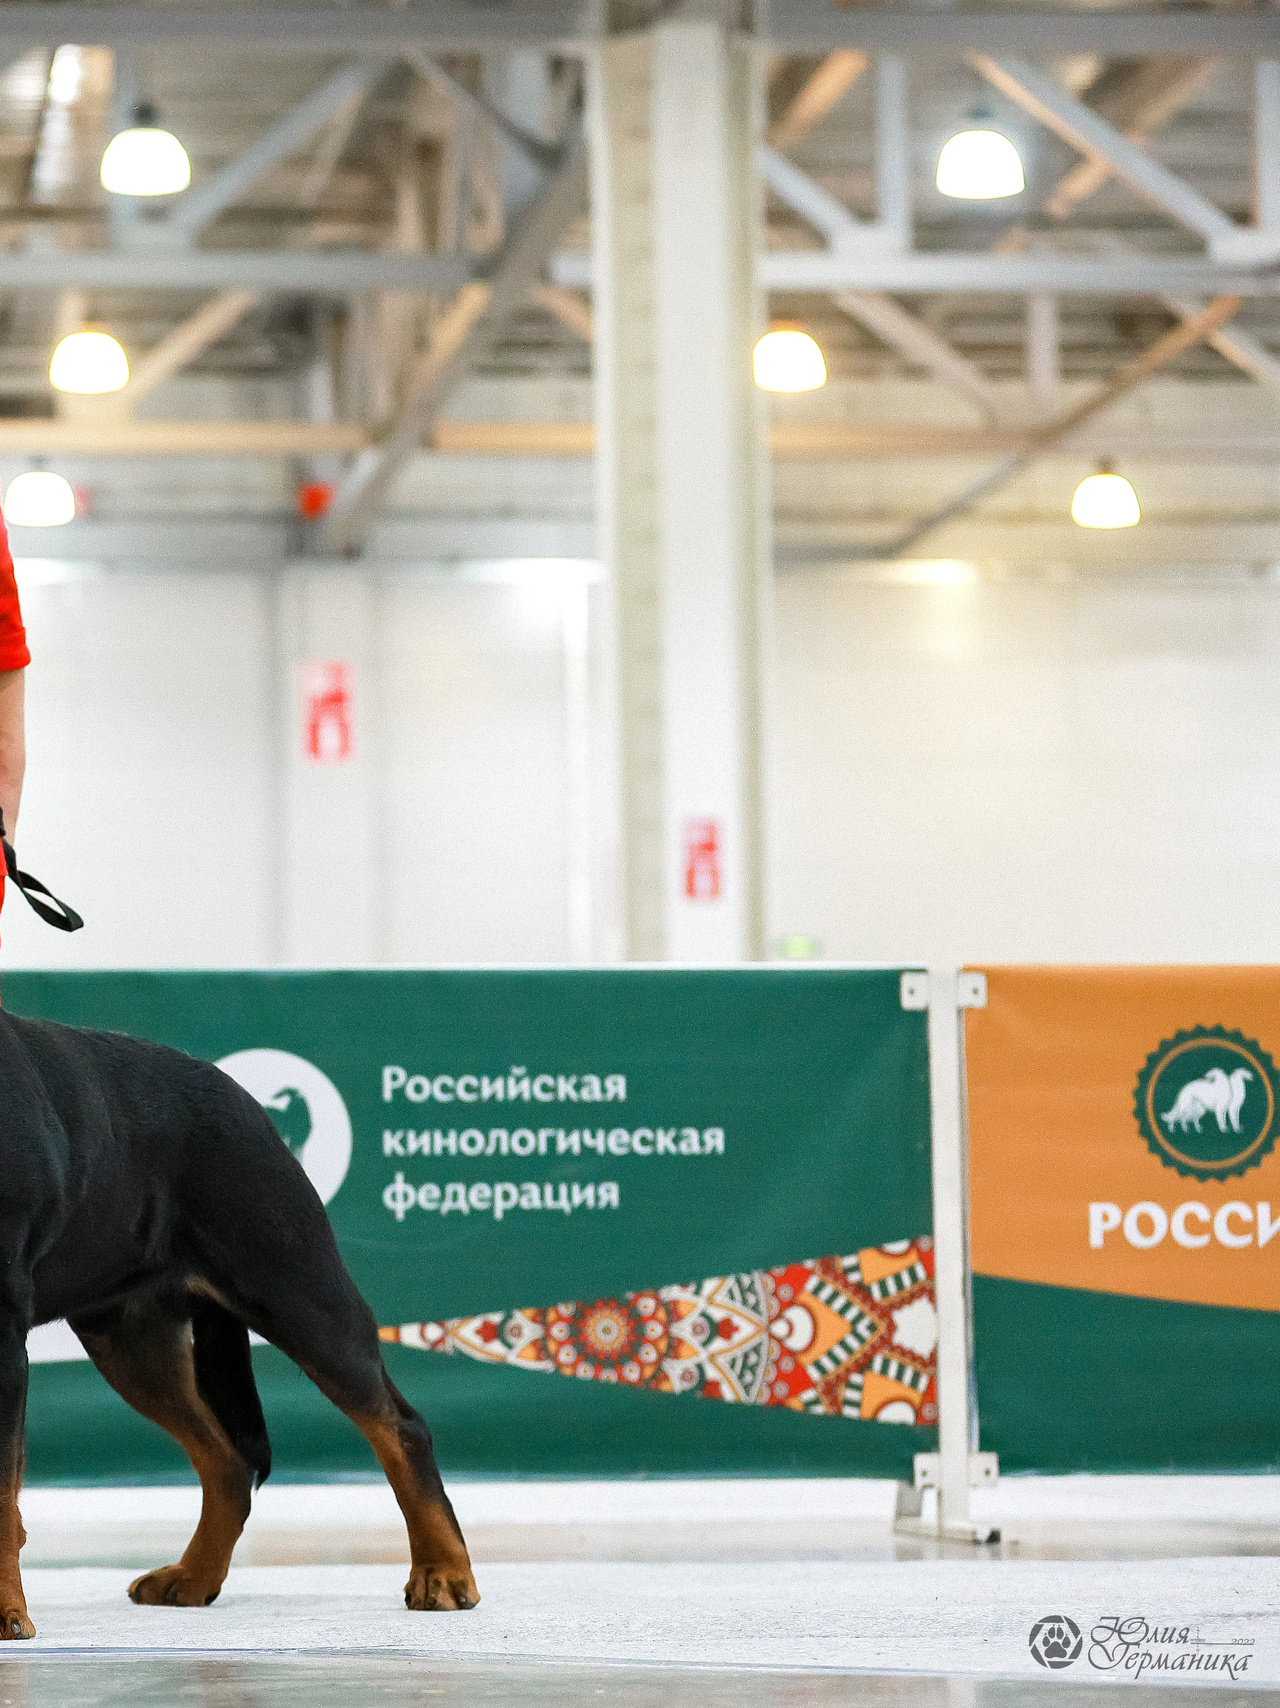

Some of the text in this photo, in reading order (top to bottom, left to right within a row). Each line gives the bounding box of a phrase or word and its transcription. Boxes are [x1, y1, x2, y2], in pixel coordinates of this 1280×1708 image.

[381, 1065, 627, 1102] Российская
[381, 1126, 725, 1157] кинологическая
[382, 1172, 620, 1221] федерация
